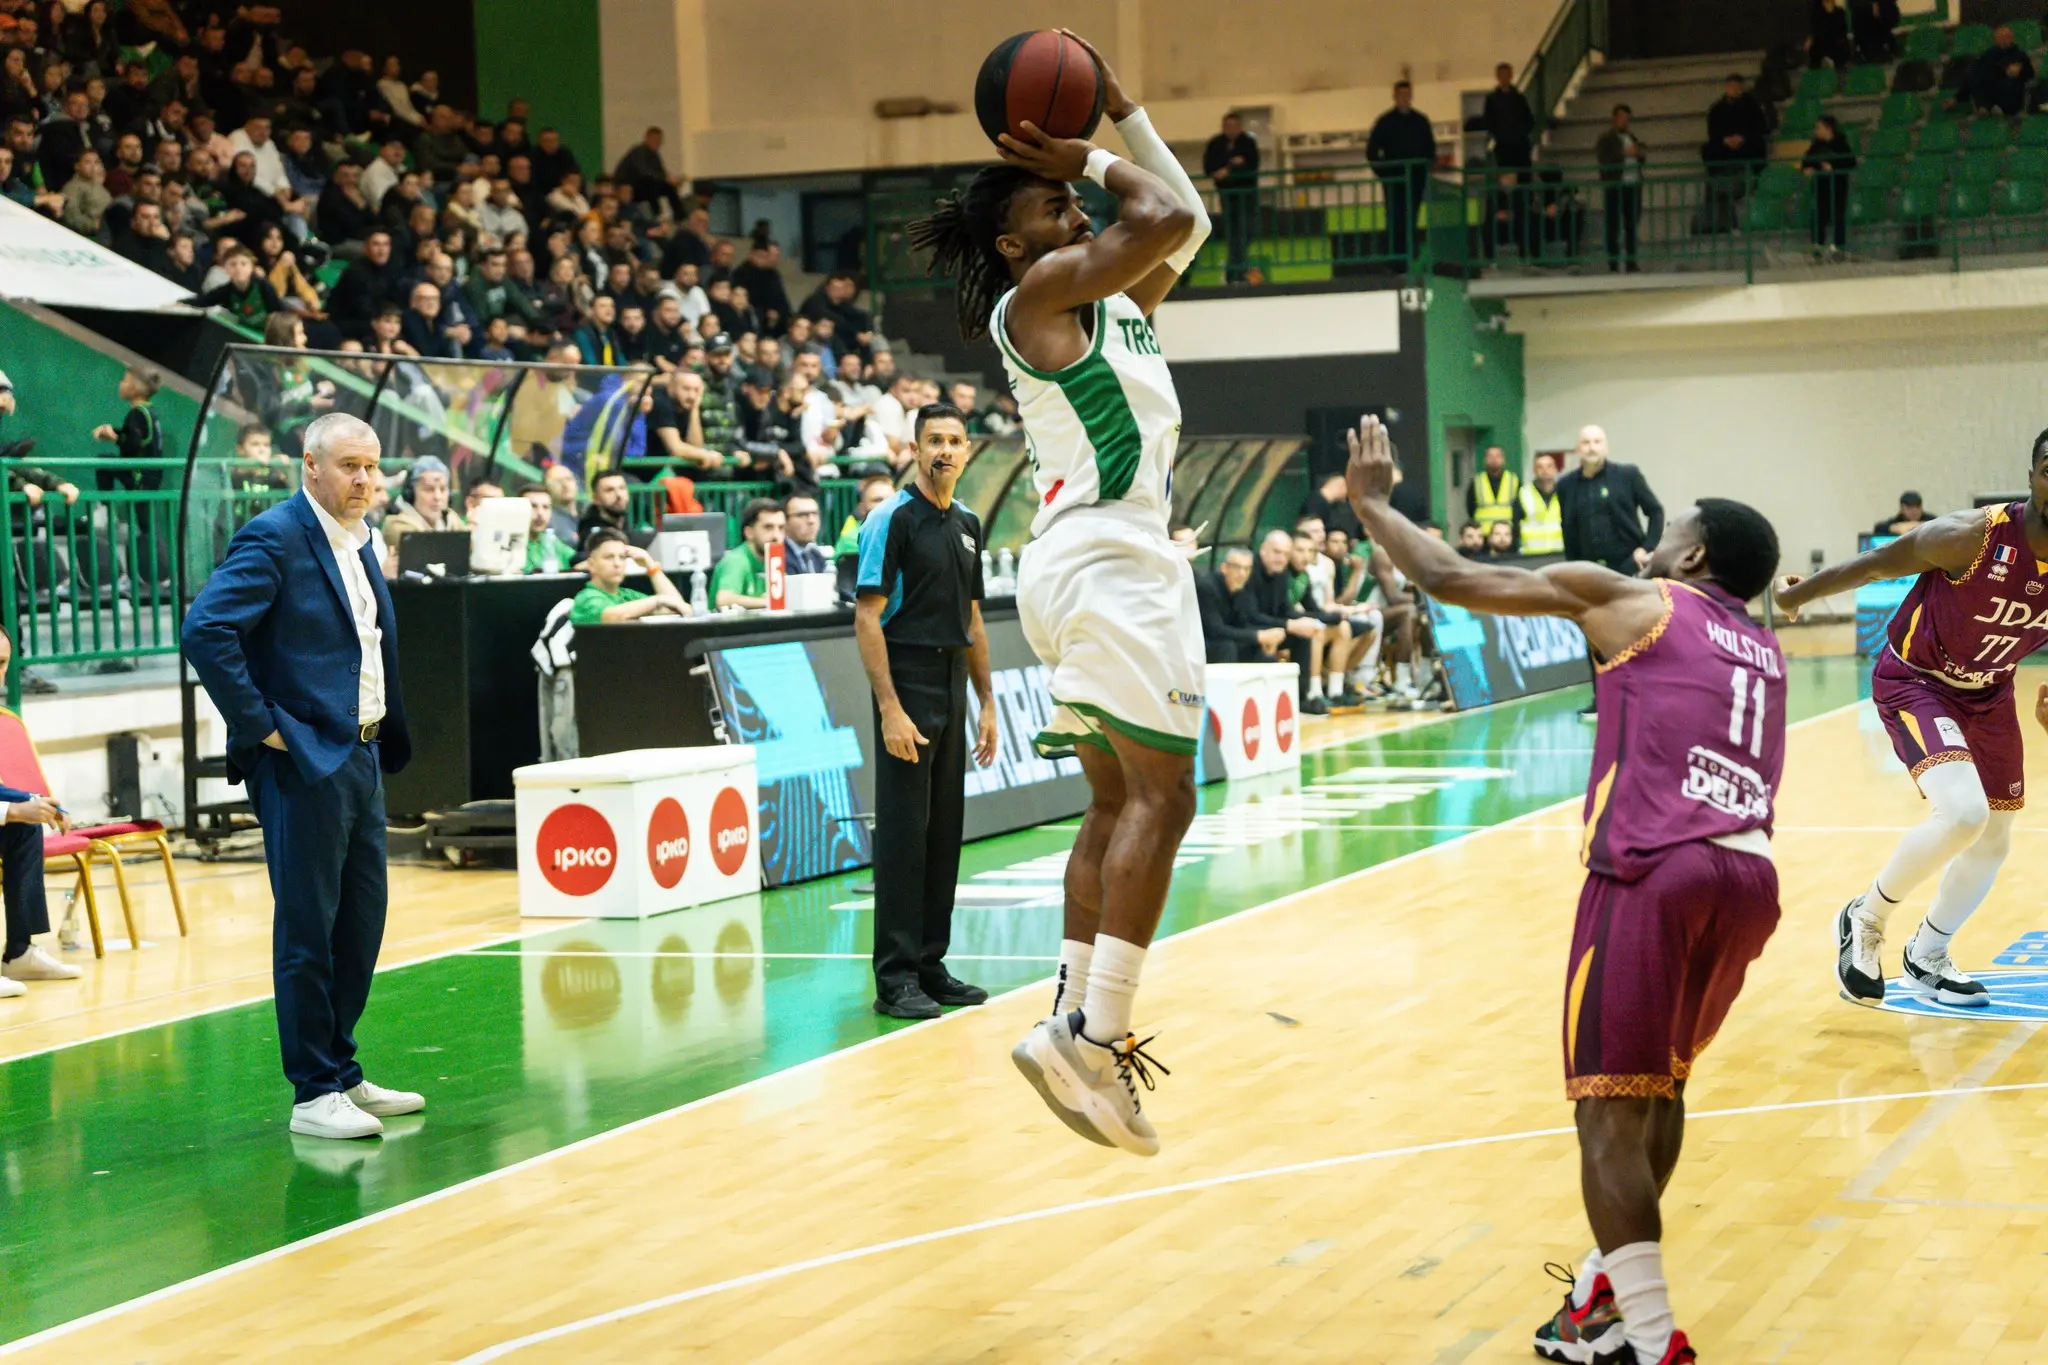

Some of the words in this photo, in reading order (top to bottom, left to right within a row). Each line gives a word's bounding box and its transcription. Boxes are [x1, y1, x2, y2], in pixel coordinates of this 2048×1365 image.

[770, 556, 783, 600] 5
[1973, 596, 2048, 631] JDA
[1973, 634, 2020, 664] 77
[1729, 666, 1766, 759] 11
[555, 847, 611, 872] ipko
